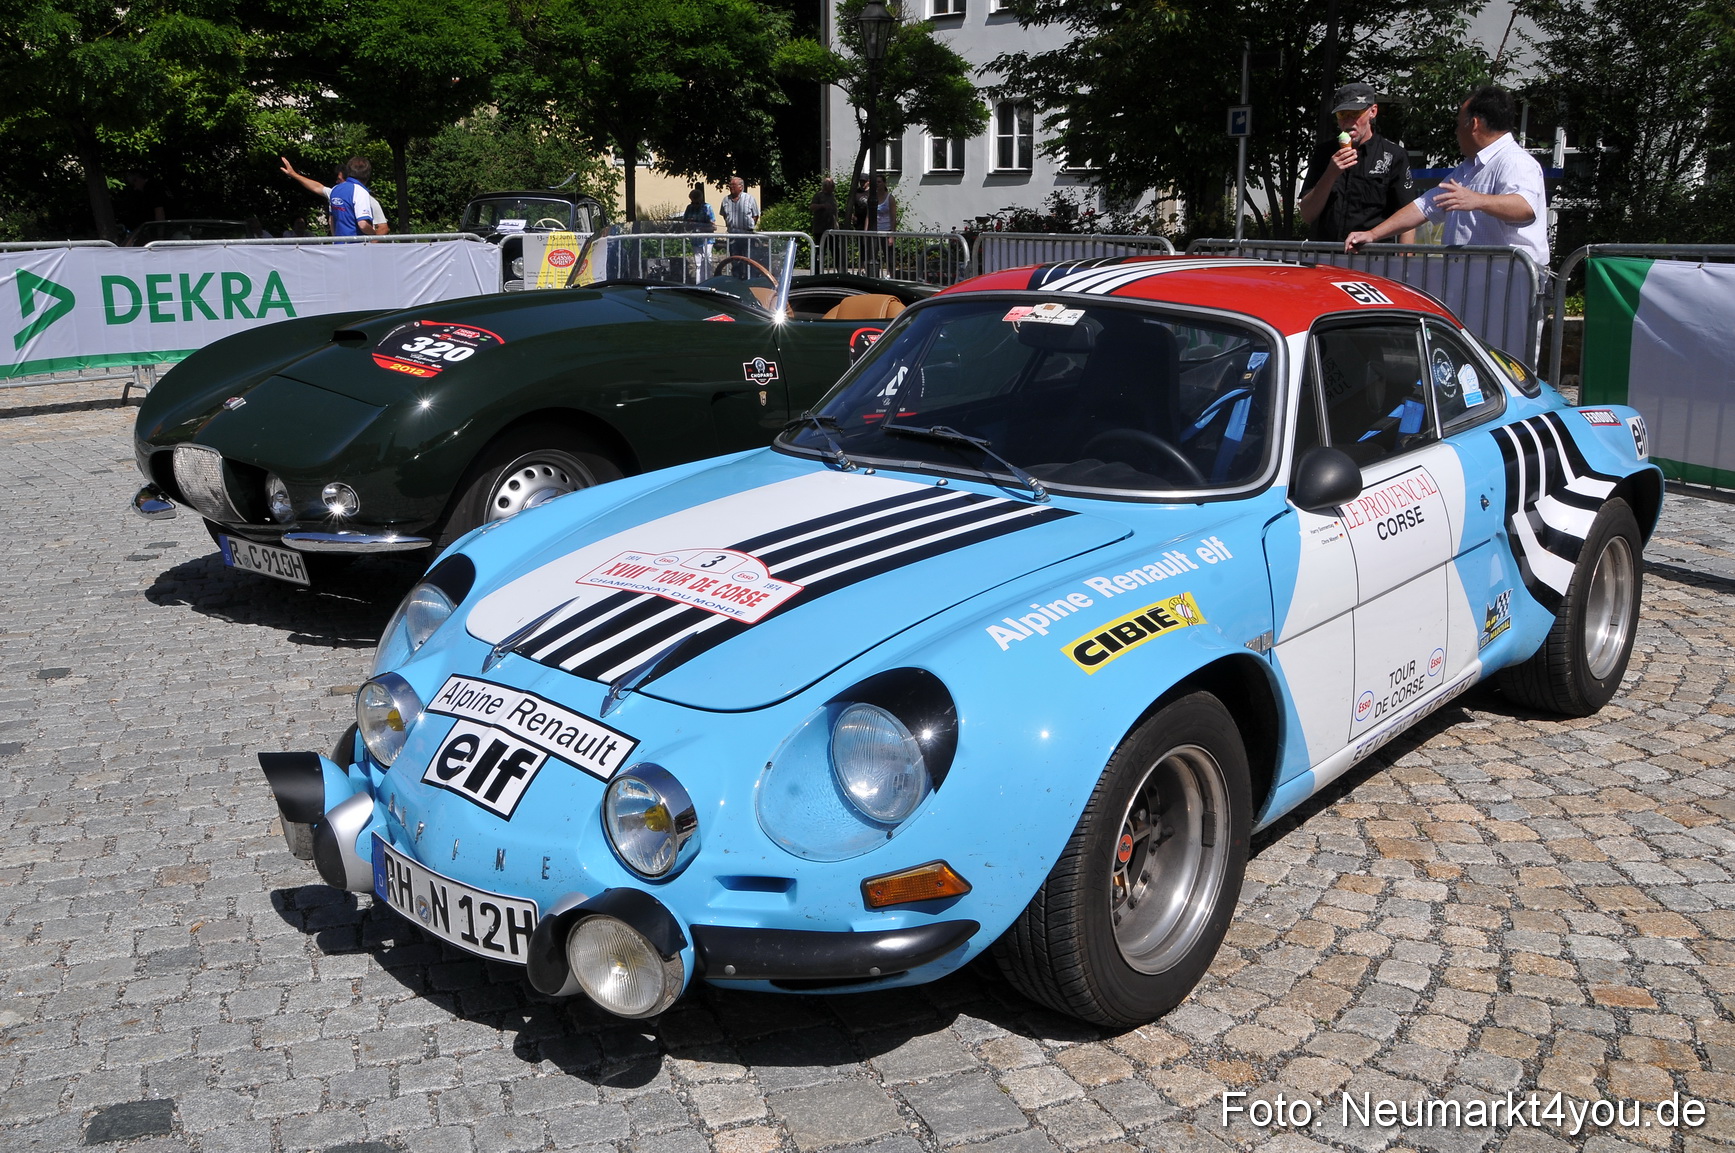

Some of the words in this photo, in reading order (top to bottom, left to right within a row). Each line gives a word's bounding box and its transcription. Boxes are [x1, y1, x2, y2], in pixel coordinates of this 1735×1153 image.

[101, 270, 297, 325] DEKRA
[1341, 283, 1388, 303] elf
[401, 337, 475, 362] 320
[390, 363, 425, 375] 2012
[1632, 418, 1648, 456] elf
[1345, 502, 1365, 529] LE
[1357, 474, 1437, 521] PROVENCAL
[1377, 506, 1424, 540] CORSE
[229, 540, 243, 565] R
[248, 545, 261, 569] C
[700, 555, 727, 568] 3
[590, 577, 669, 592] CHAMPIONAT
[671, 591, 692, 600] DU
[693, 597, 746, 616] MONDE
[652, 569, 692, 586] TOUR
[688, 577, 719, 592] DE
[711, 583, 770, 608] CORSE
[763, 582, 782, 592] 1974
[985, 591, 1094, 651] Alpine
[1083, 549, 1199, 598] Renault
[1195, 536, 1233, 564] elf
[1389, 659, 1416, 688] TOUR
[1431, 656, 1442, 669] Esso
[1358, 699, 1371, 713] Esso
[1375, 696, 1389, 719] DE
[1391, 674, 1425, 708] CORSE
[439, 681, 504, 715] Alpine
[507, 697, 617, 767] Renault
[436, 733, 538, 804] elf
[384, 850, 416, 914] RH
[430, 880, 450, 934] N
[458, 895, 534, 956] 12H
